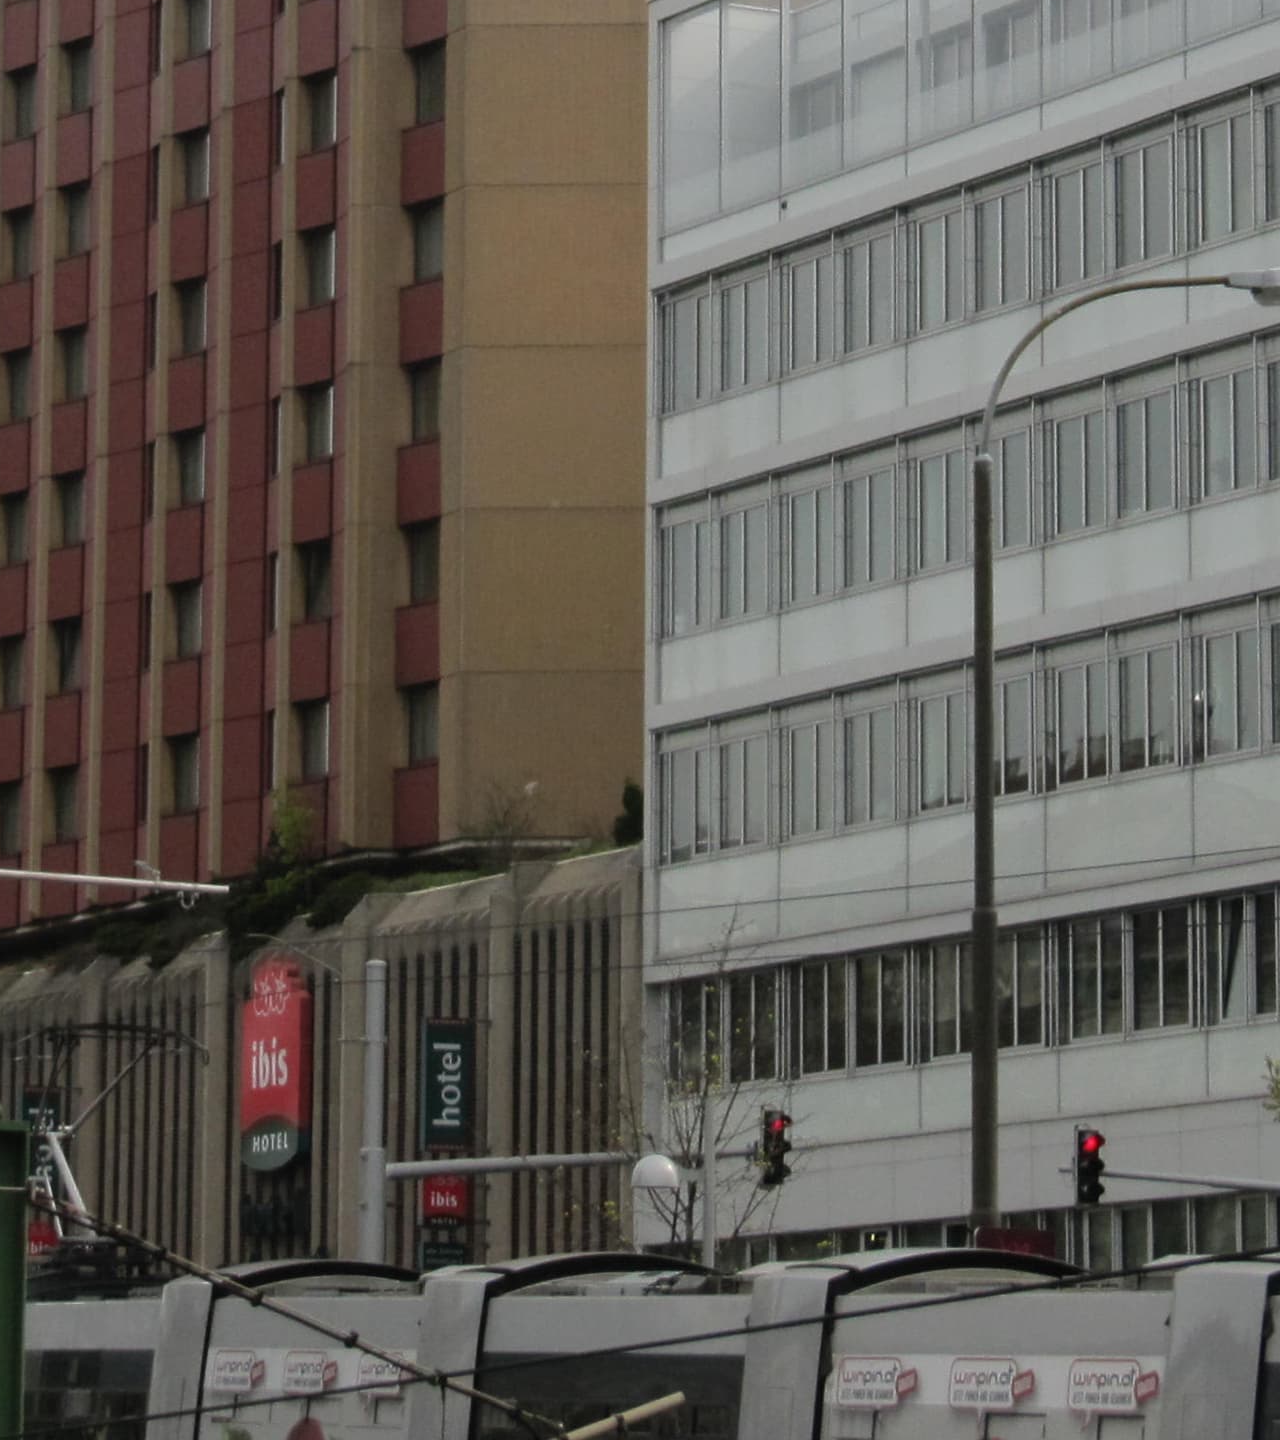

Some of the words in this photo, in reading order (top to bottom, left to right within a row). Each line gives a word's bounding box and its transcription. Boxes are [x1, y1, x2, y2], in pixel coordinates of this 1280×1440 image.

[251, 1037, 288, 1089] ibis
[432, 1043, 461, 1126] hotel
[252, 1131, 288, 1152] HOTEL
[431, 1191, 457, 1208] ibis
